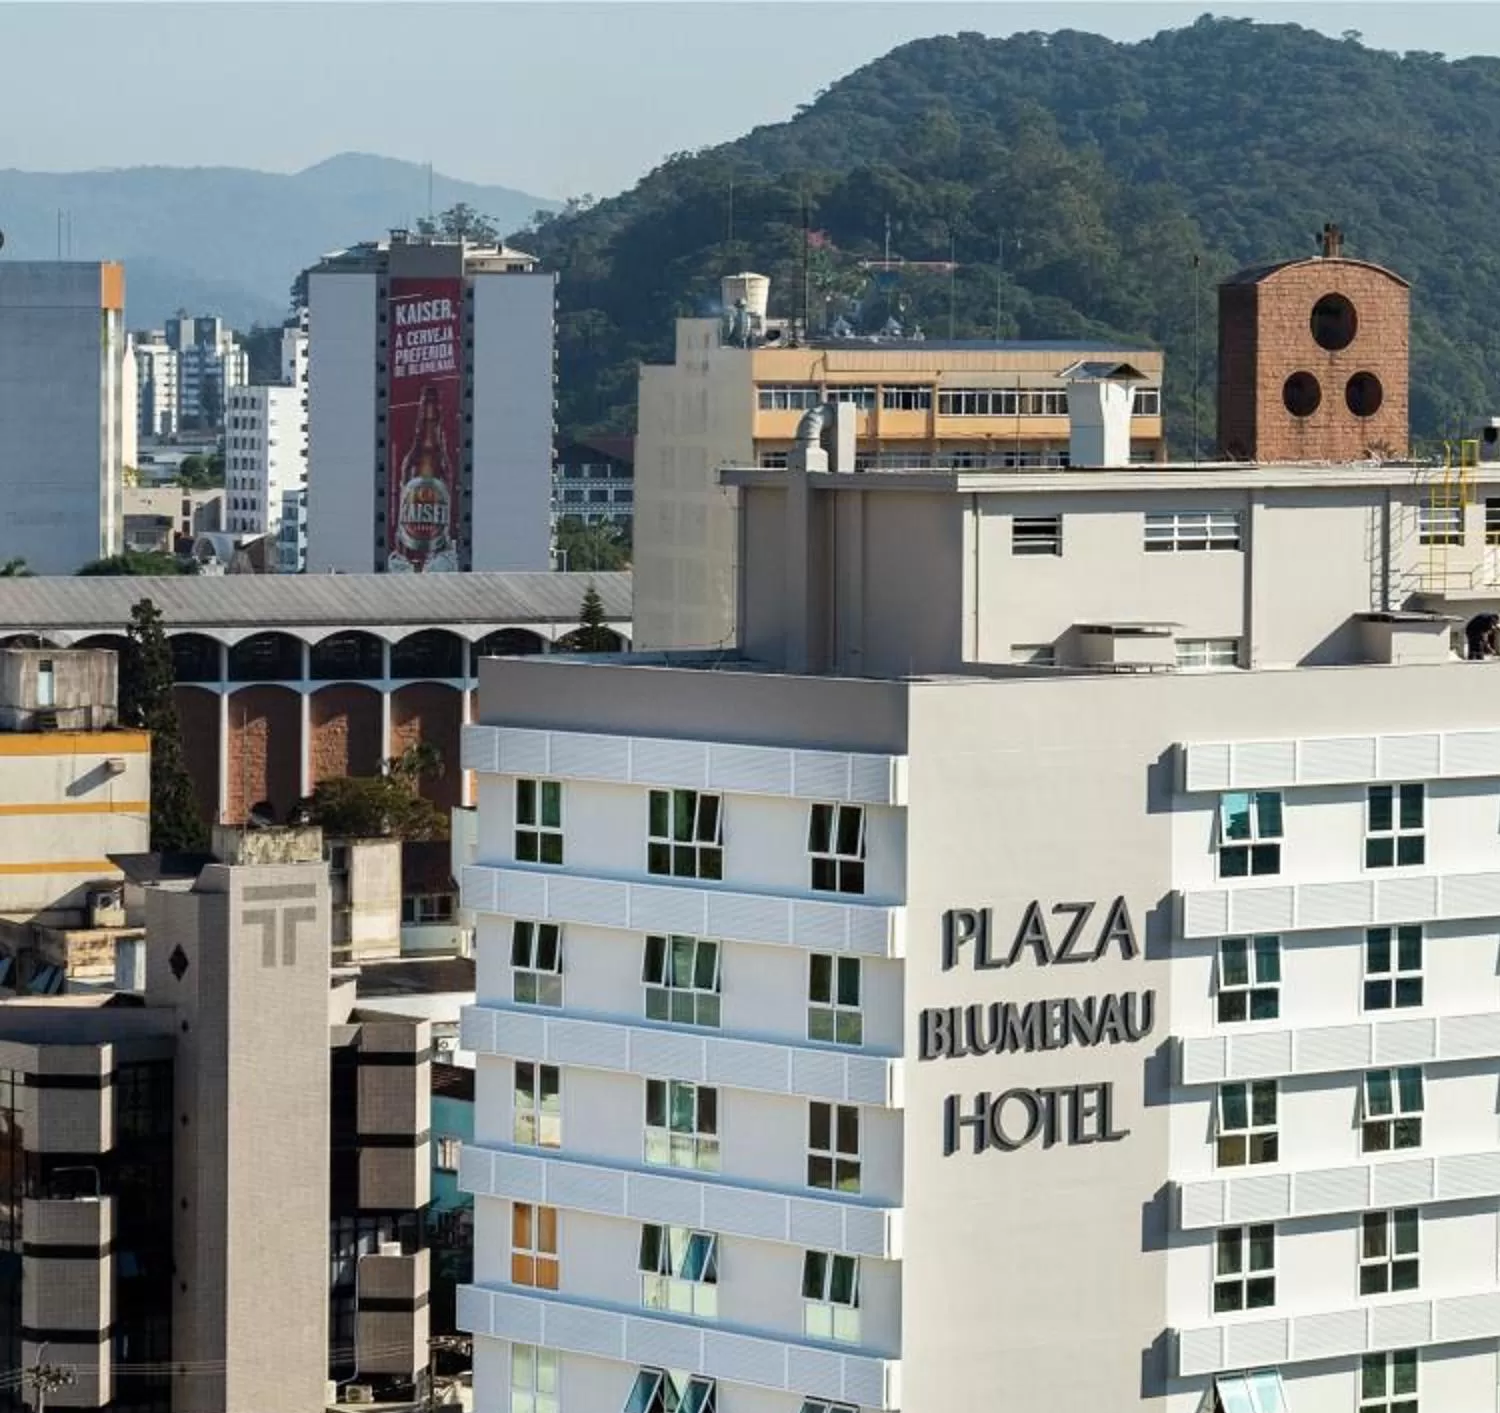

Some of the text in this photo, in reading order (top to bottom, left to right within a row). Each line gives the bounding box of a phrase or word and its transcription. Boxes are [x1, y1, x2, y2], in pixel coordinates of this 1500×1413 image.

[396, 299, 457, 325] KAISER.
[396, 325, 453, 348] A CERVEJA
[941, 895, 1140, 972] PLAZA
[918, 989, 1156, 1062] BLUMENAU
[943, 1081, 1131, 1158] HOTEL
